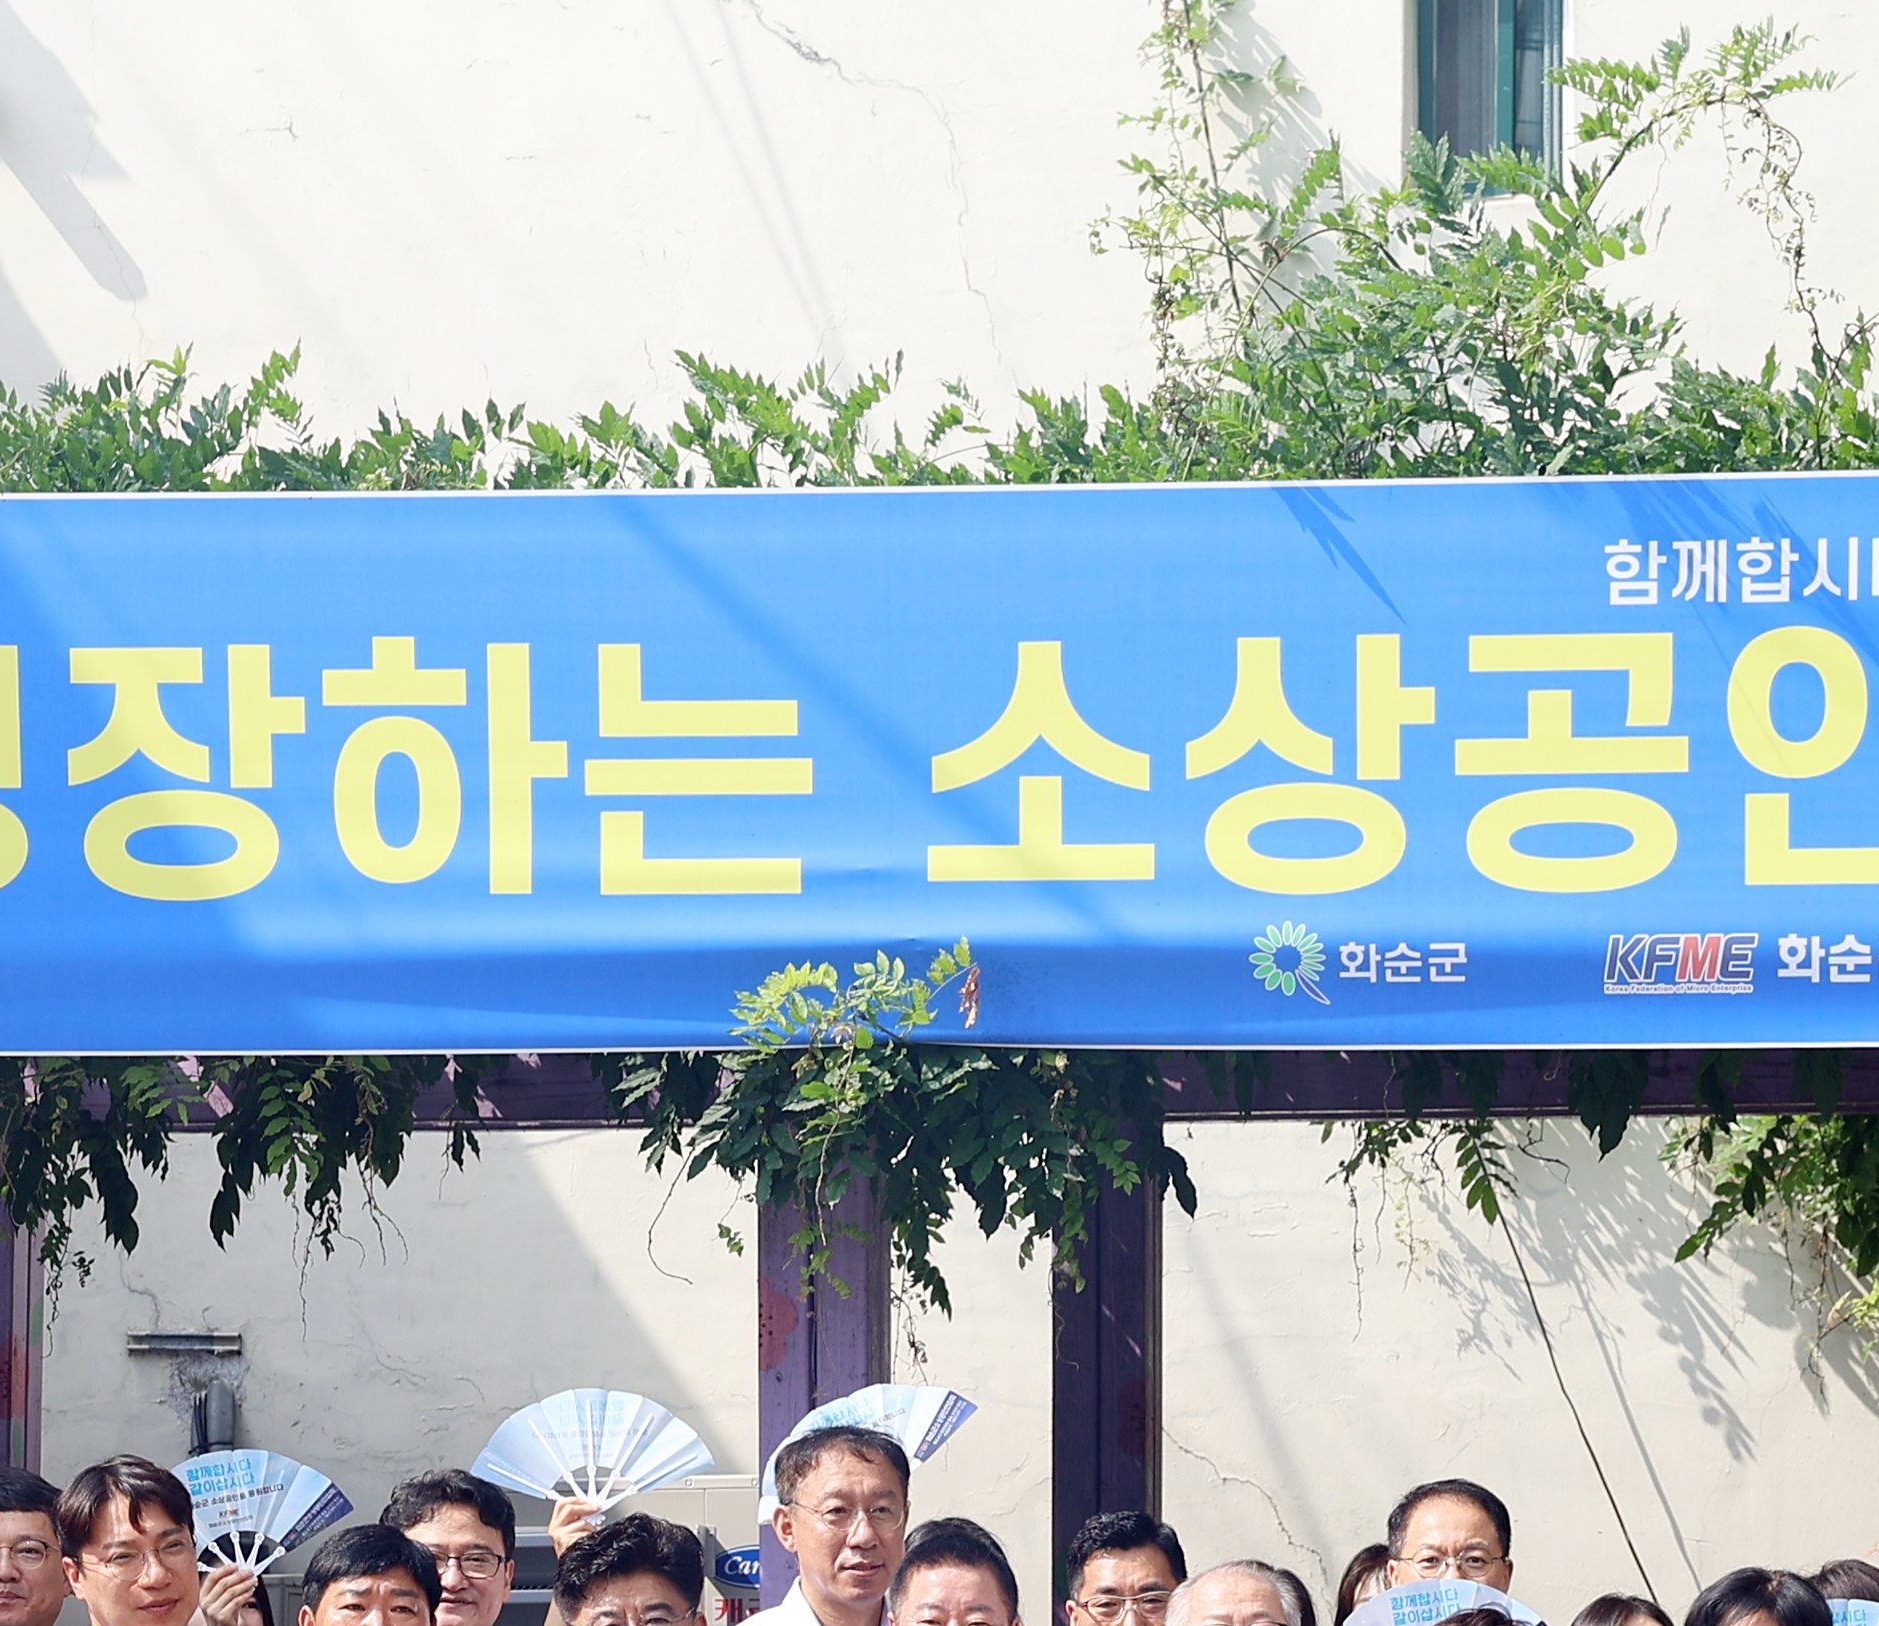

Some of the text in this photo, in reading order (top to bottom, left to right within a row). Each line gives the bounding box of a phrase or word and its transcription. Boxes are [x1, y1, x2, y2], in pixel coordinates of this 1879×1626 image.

[1339, 939, 1469, 987] 화순군
[1604, 932, 1759, 983] KFME
[1604, 984, 1753, 995] Korea Federation of Micro Enterprise
